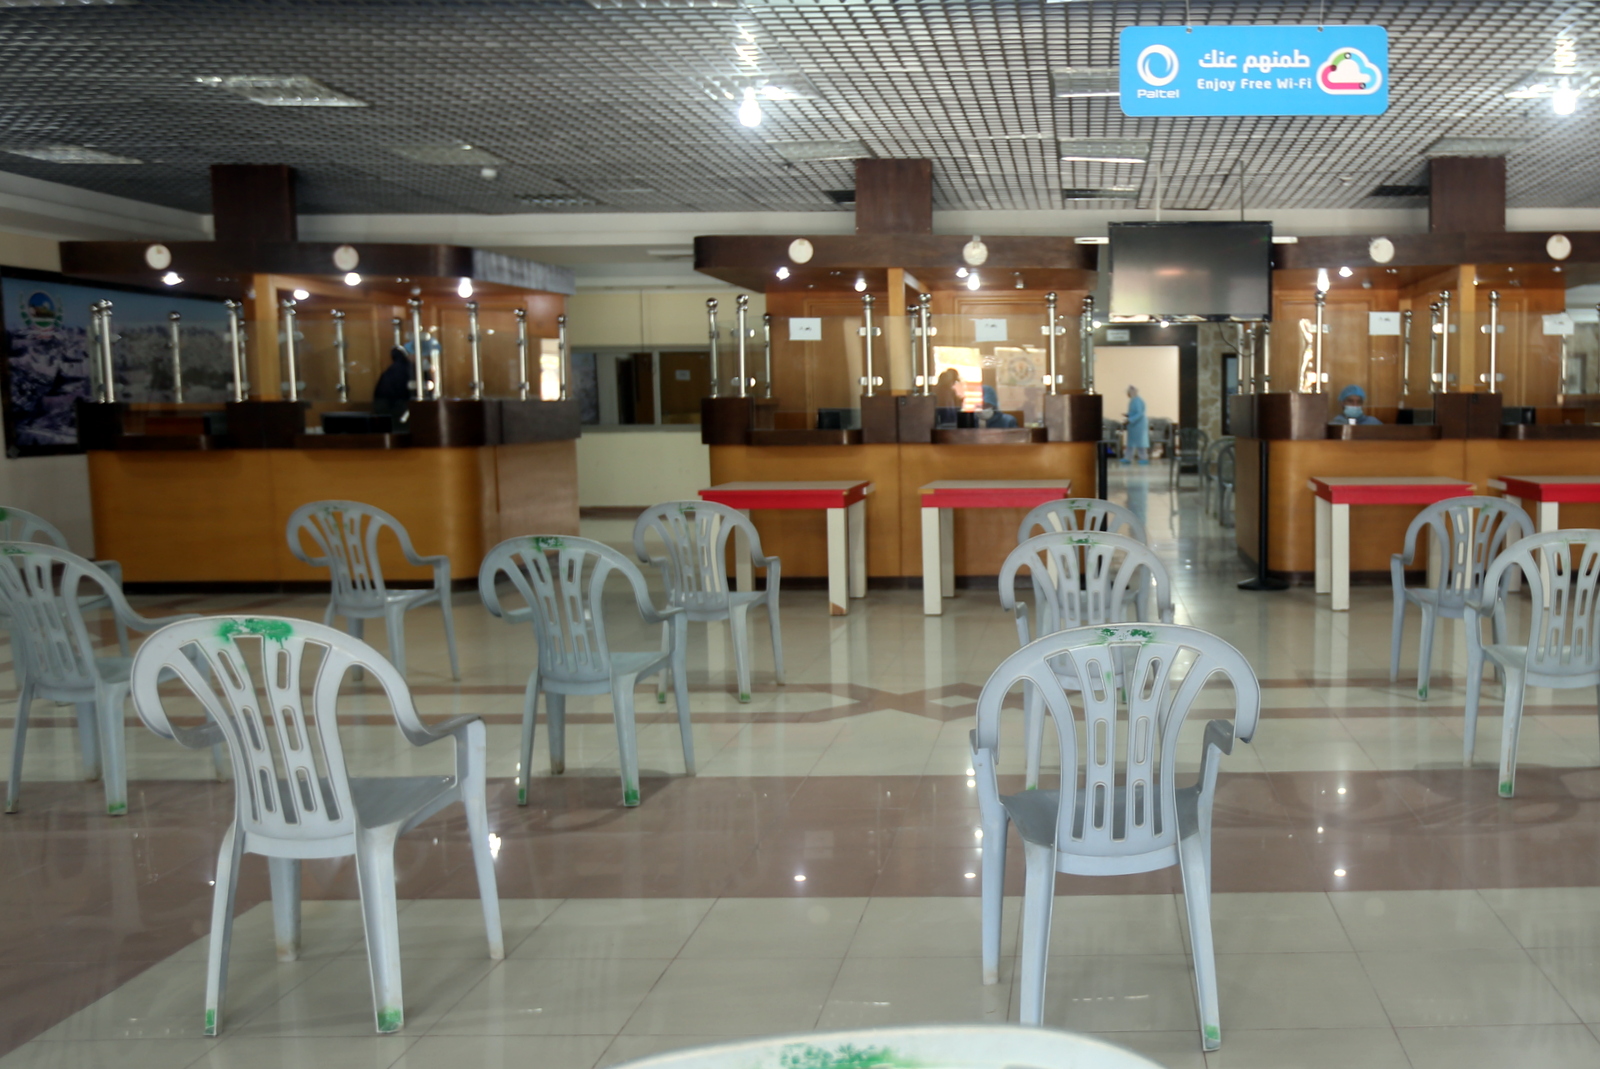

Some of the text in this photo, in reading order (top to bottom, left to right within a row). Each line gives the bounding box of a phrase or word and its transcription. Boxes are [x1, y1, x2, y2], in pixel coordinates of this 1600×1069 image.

[1198, 48, 1311, 74] طمنهم عنك
[1196, 78, 1313, 92] Enjoy Free Wi-Fi
[1136, 88, 1180, 99] Paltel
